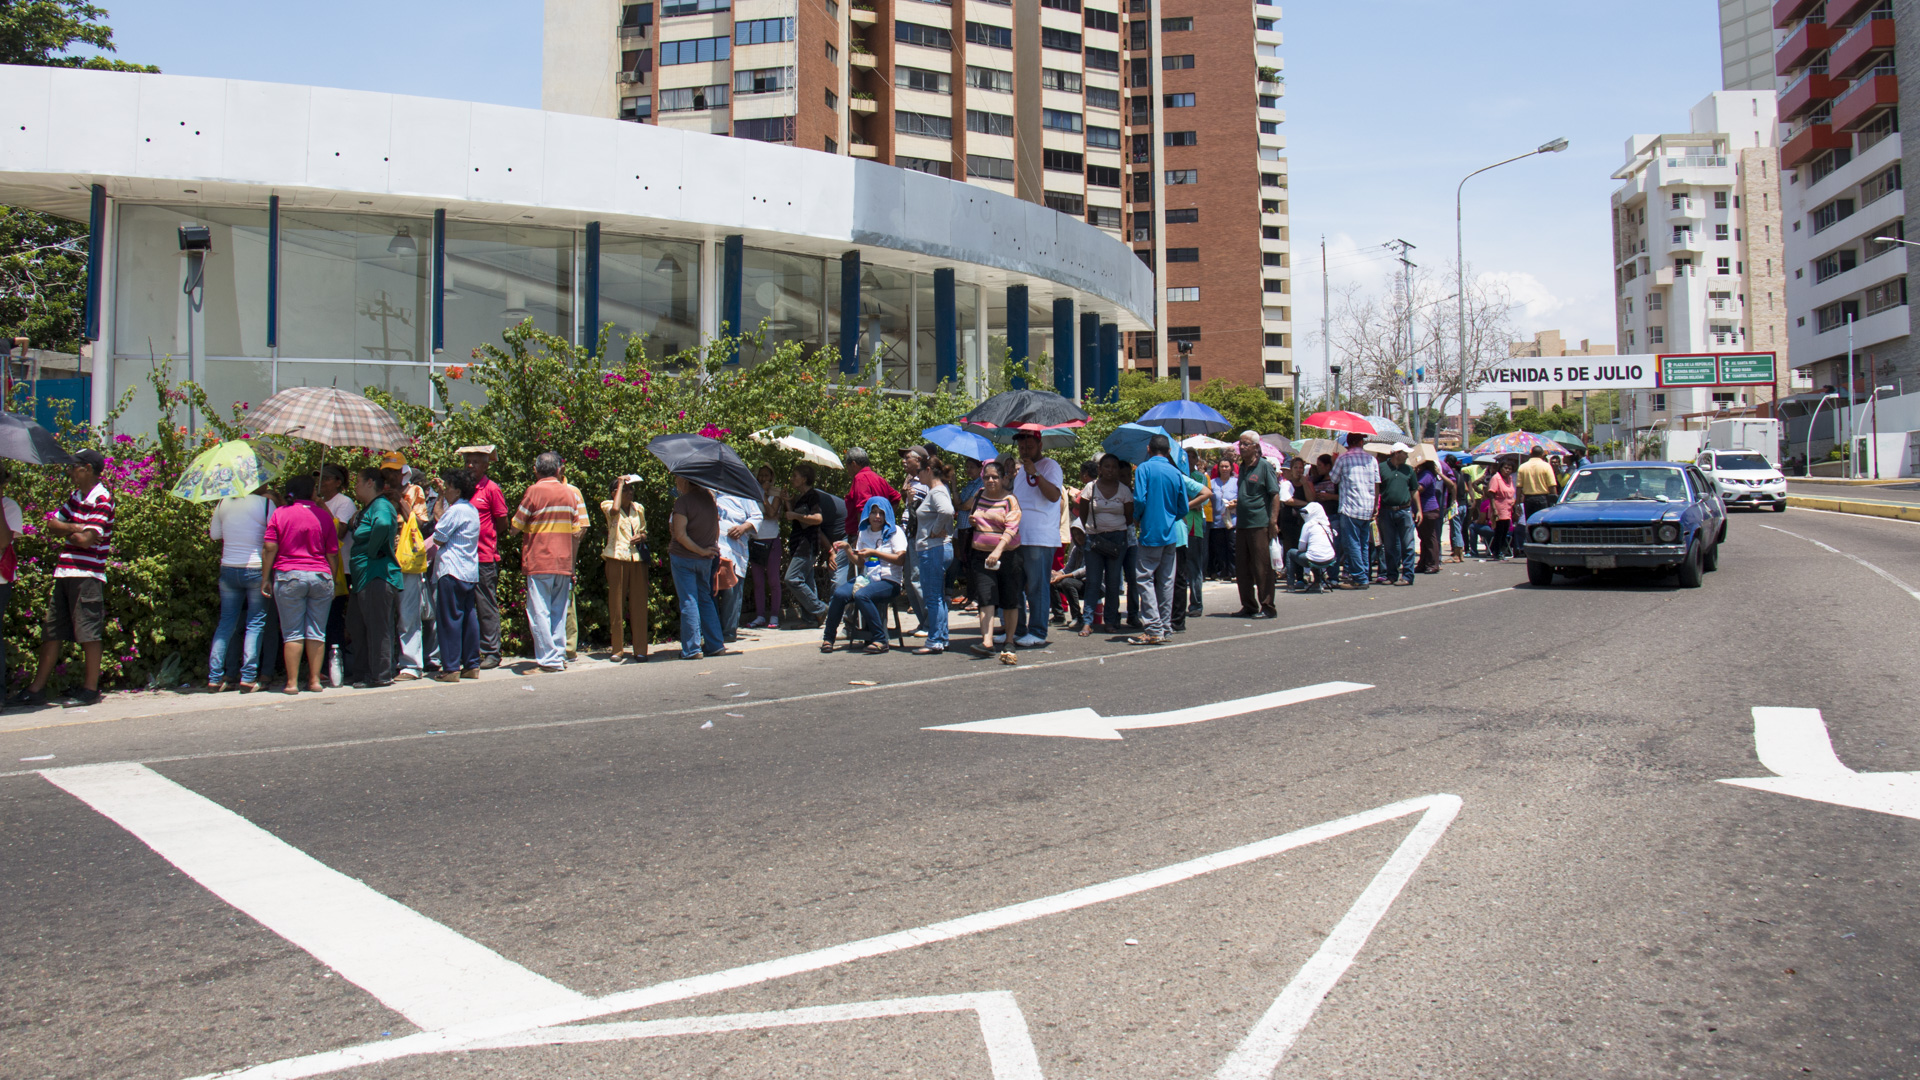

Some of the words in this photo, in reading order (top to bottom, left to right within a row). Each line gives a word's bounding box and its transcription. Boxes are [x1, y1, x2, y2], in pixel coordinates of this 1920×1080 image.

[1479, 368, 1549, 382] AVENIDA
[1554, 367, 1563, 381] 5
[1567, 367, 1589, 381] DE
[1593, 365, 1643, 380] JULIO
